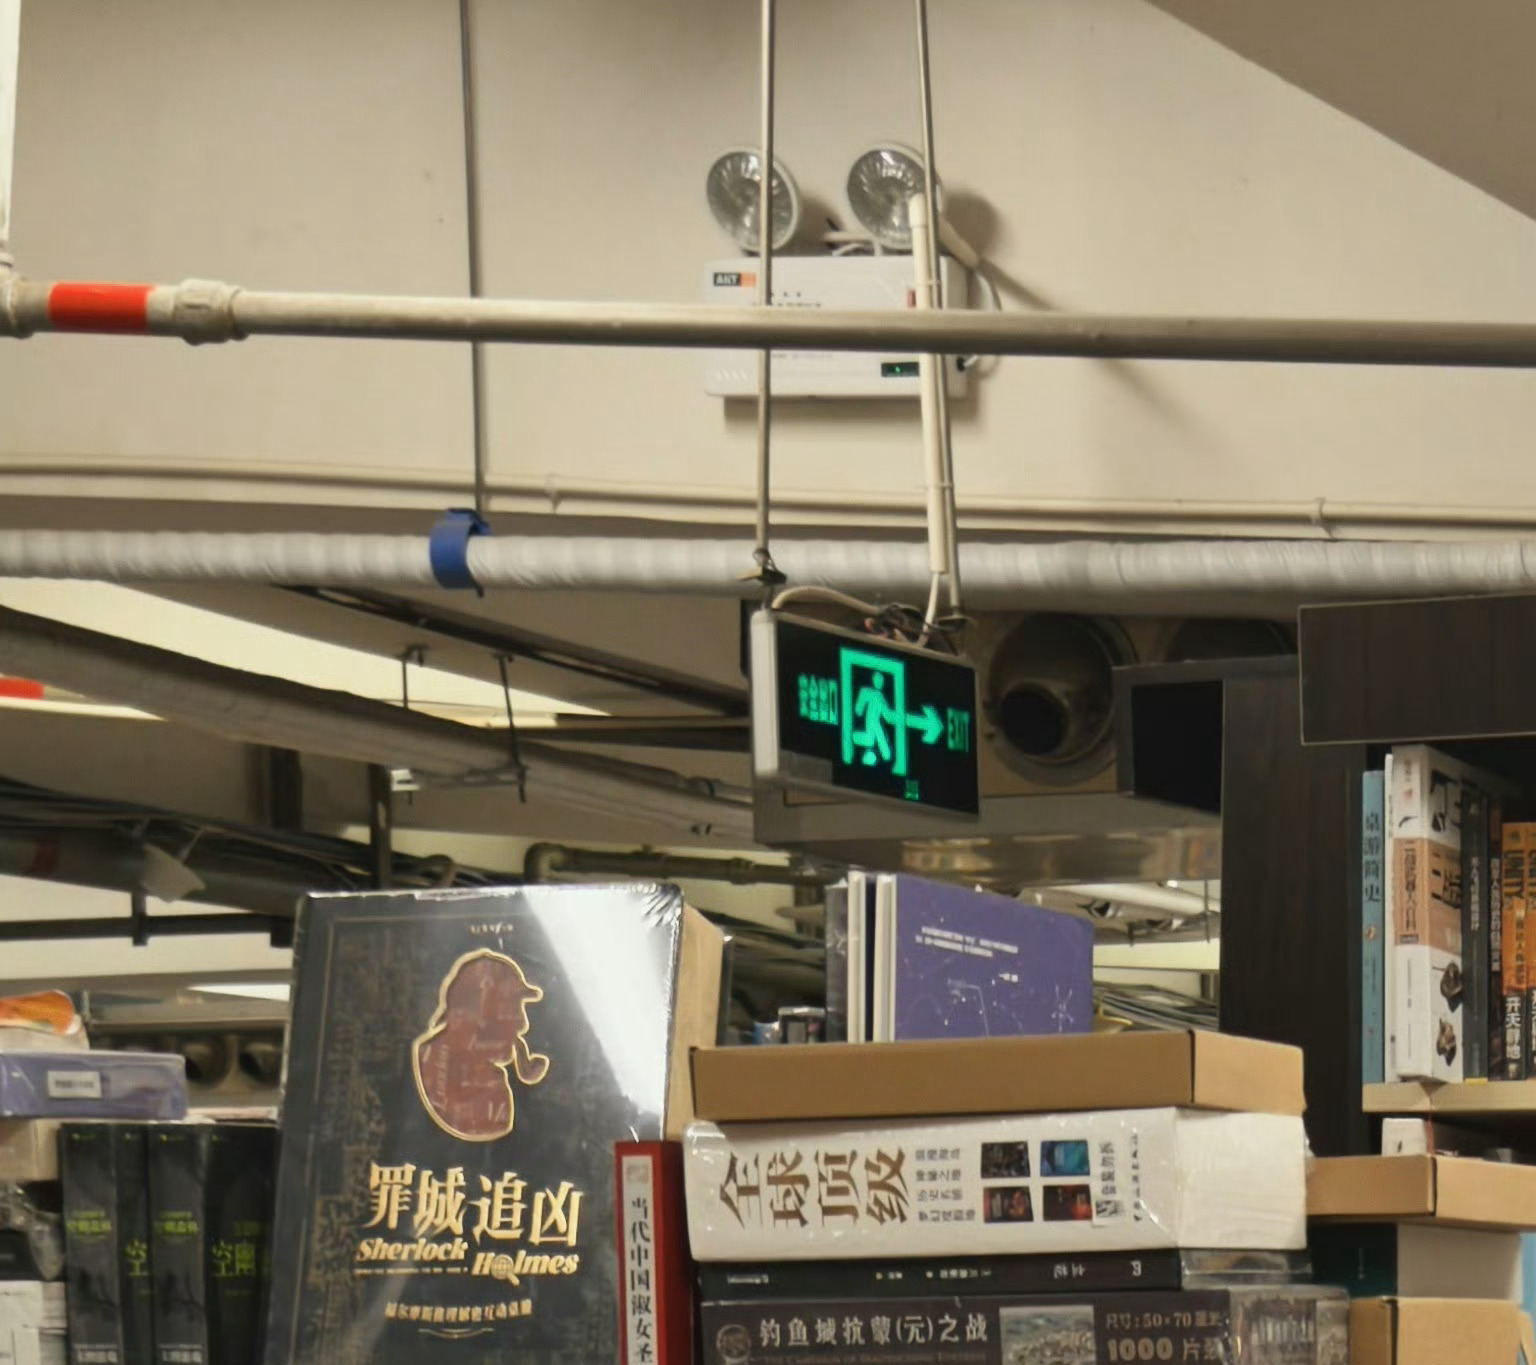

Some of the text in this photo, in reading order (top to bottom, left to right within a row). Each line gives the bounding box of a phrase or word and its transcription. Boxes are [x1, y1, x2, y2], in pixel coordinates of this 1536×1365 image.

[364, 1161, 584, 1247] 罪城追凶
[719, 1148, 910, 1230] 全球顶级
[354, 1237, 469, 1263] Sherlock
[1107, 1337, 1174, 1361] 1000
